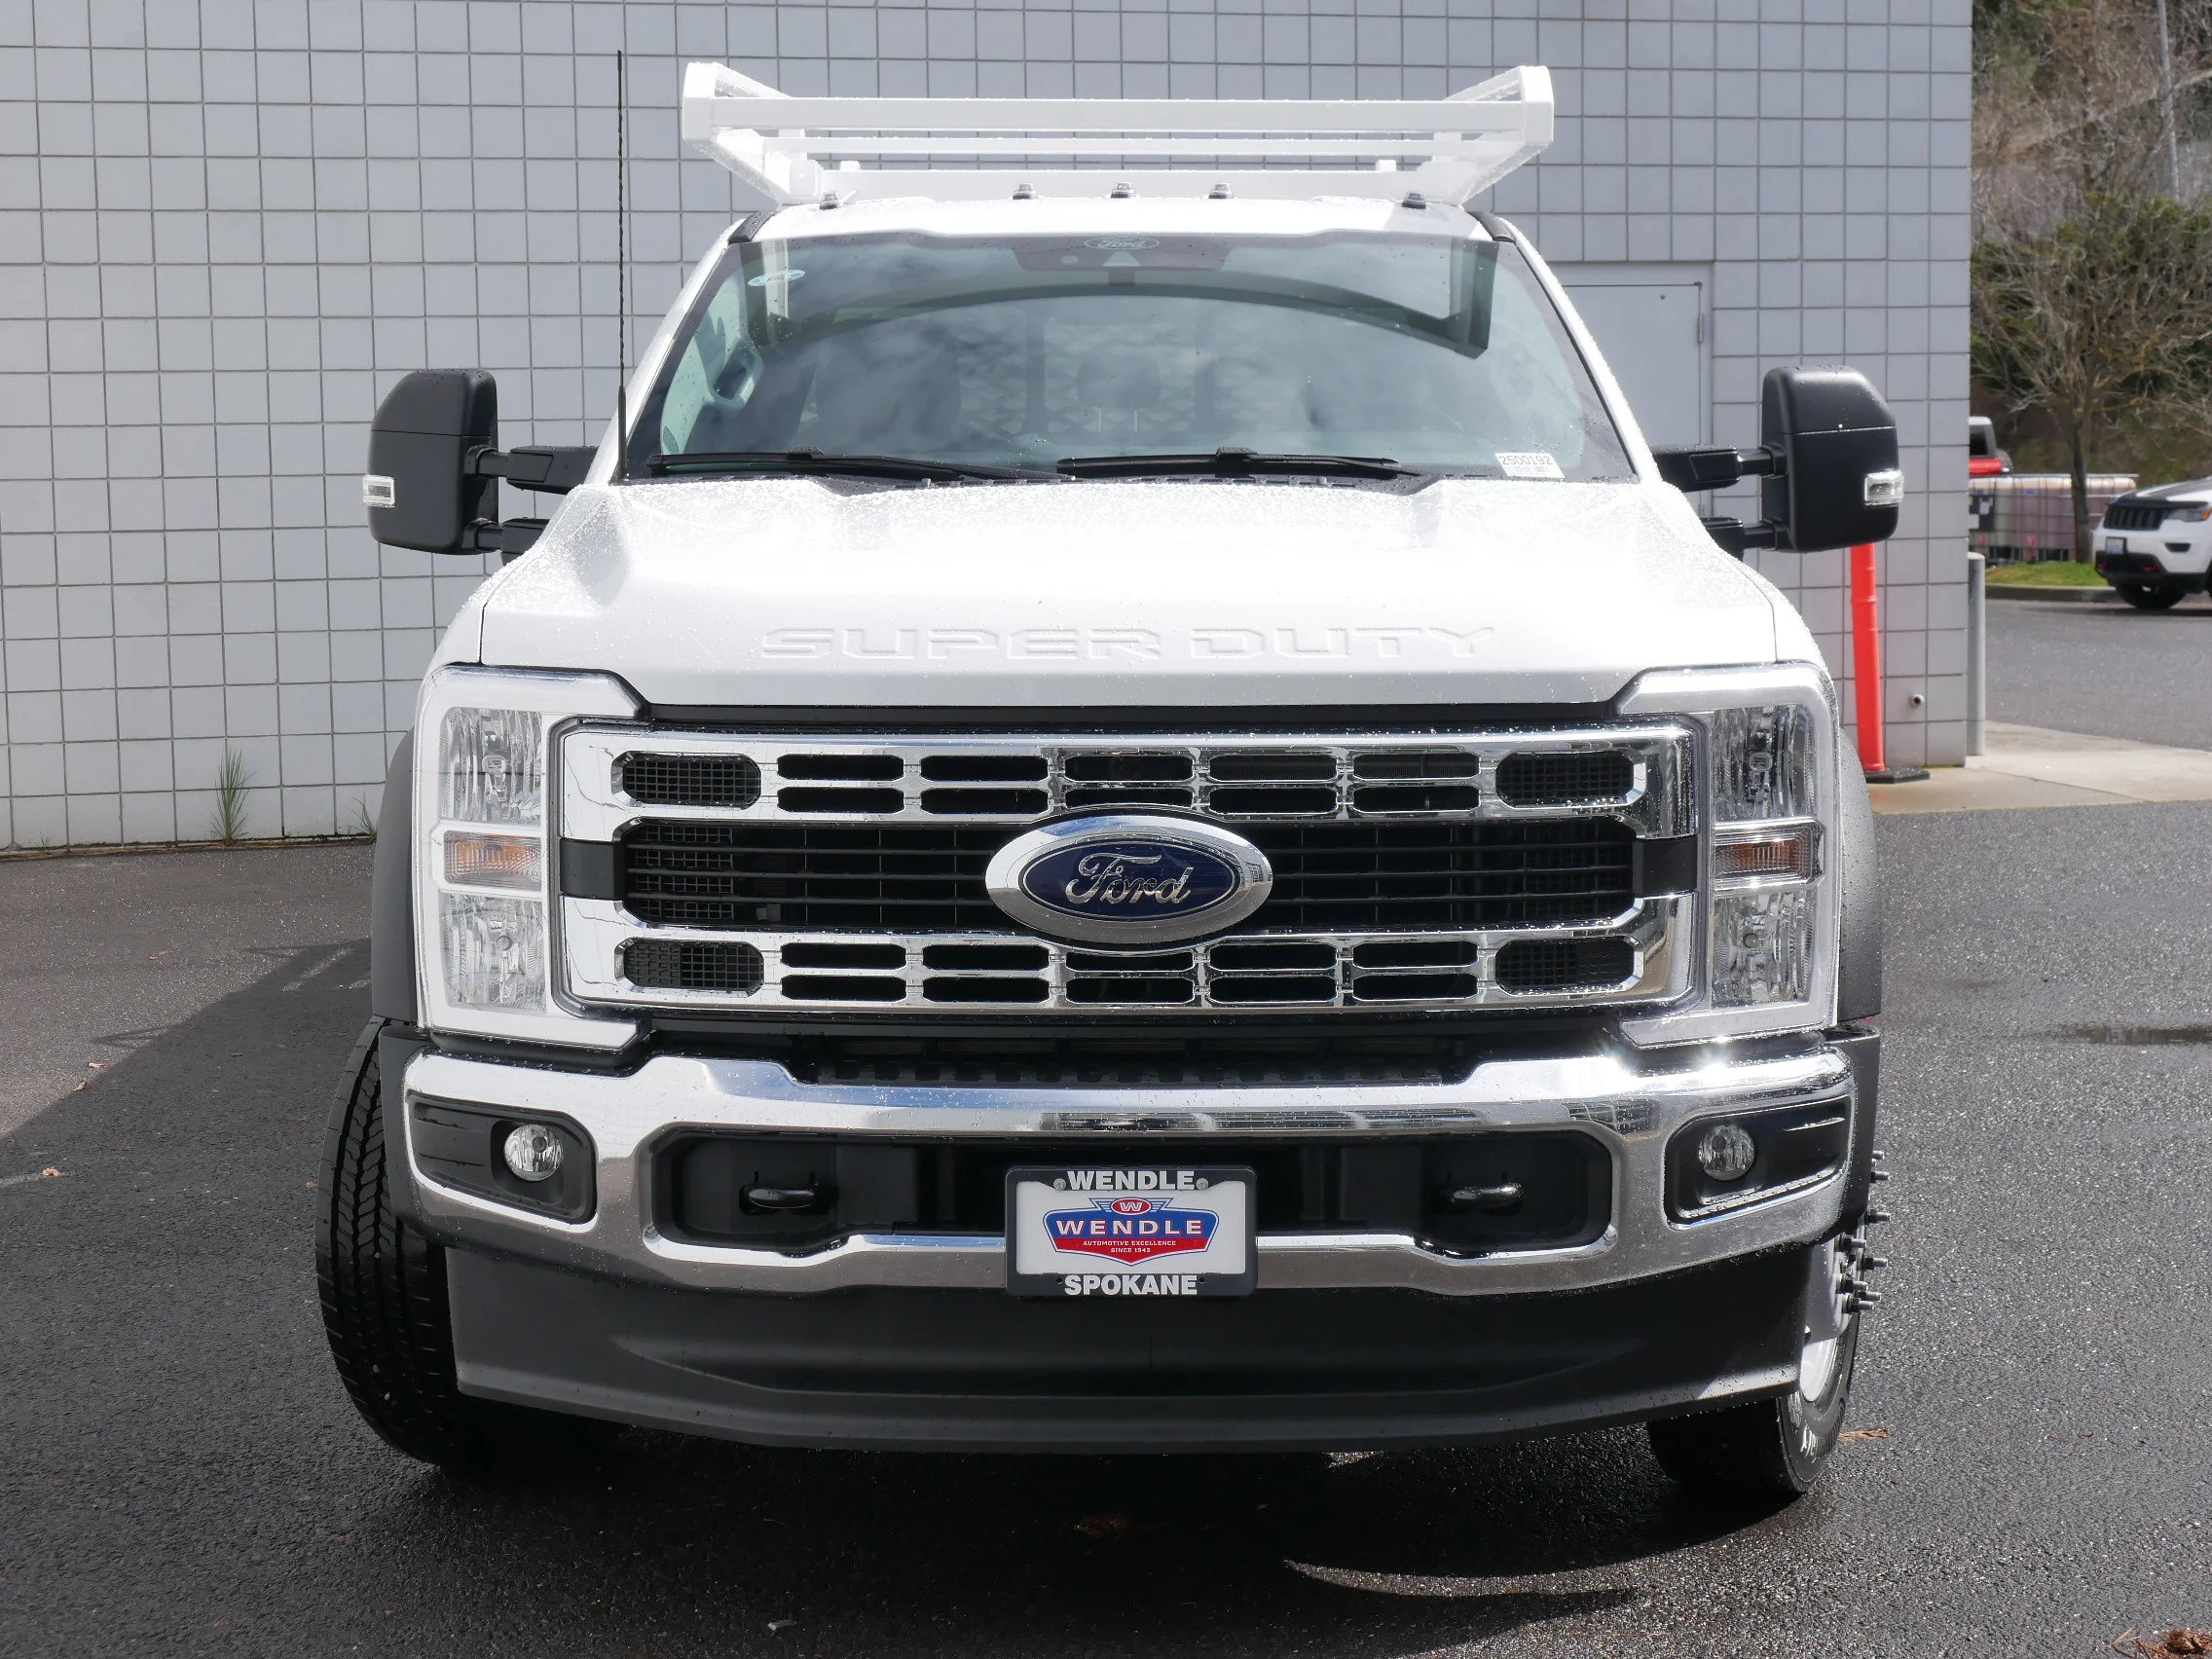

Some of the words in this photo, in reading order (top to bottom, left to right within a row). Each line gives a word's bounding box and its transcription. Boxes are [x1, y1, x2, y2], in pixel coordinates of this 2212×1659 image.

[1498, 455, 1553, 465] 2500192
[761, 626, 1162, 660] SUPER
[1191, 626, 1495, 660] DUTY
[1065, 852, 1195, 904] Ford
[1067, 1170, 1195, 1191] WENDLE
[1055, 1220, 1203, 1235] WENDLE
[1064, 1274, 1198, 1296] SPOKANE
